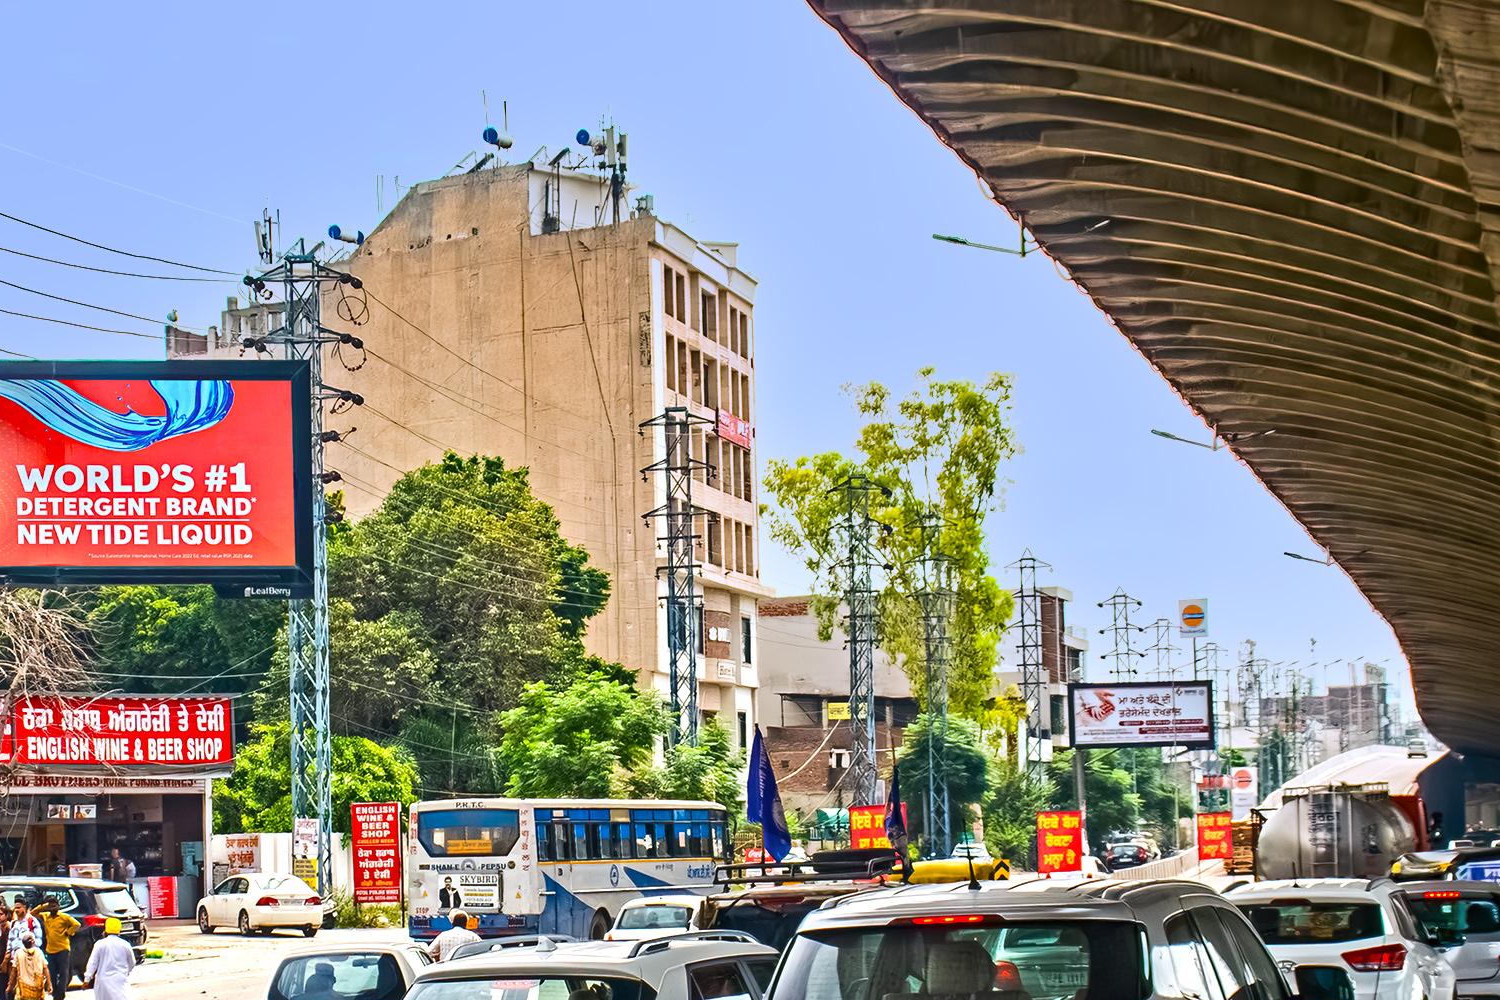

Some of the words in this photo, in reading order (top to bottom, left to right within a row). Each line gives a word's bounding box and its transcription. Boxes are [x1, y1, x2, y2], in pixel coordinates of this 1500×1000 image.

[204, 463, 251, 492] #1
[16, 498, 160, 516] DETERGENT
[17, 524, 81, 545] NEW
[86, 524, 149, 545] TIDE
[156, 524, 252, 546] LIQUID
[27, 736, 90, 760] ENGLISH
[93, 738, 129, 761] WINE
[134, 738, 144, 760] &
[148, 738, 183, 761] BEER
[187, 738, 223, 760] SHOP
[355, 805, 396, 815] ENGLISH
[356, 814, 384, 823] WINE
[386, 813, 395, 822] &
[361, 822, 390, 830] BEER
[361, 830, 391, 839] SHOP
[481, 862, 507, 870] PEPSU
[460, 875, 498, 884] SKYBIRD
